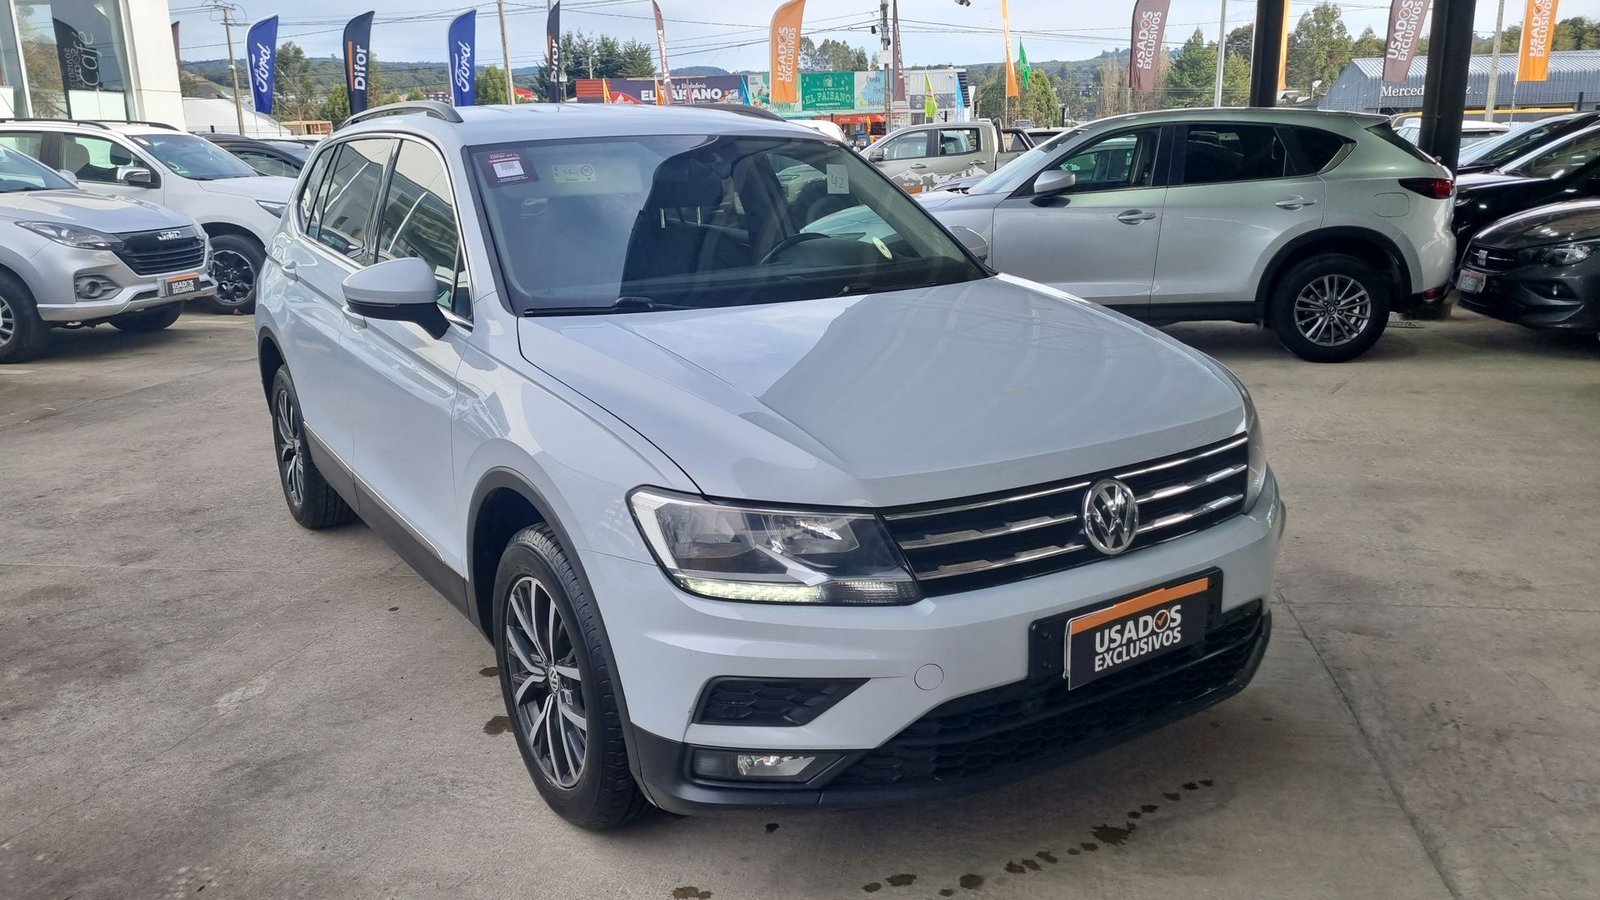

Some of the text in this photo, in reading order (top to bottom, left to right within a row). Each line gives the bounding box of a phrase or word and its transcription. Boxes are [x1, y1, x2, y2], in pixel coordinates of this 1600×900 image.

[777, 26, 788, 81] USADOS
[1136, 11, 1153, 68] USADOS
[1143, 11, 1161, 69] EXCLUSIVOS
[1535, 0, 1553, 57] EXCLUSIVO
[72, 31, 102, 86] Café
[252, 42, 271, 93] Ford
[354, 45, 367, 91] Difor
[455, 41, 471, 93] Ford
[785, 27, 796, 82] EXCLUSIVOS
[641, 89, 722, 101] EL AISANO
[805, 91, 851, 104] EL PAISANO
[830, 174, 845, 189] 42
[1094, 604, 1182, 654] USADOS
[1094, 626, 1182, 672] EXCLUSIVOS
